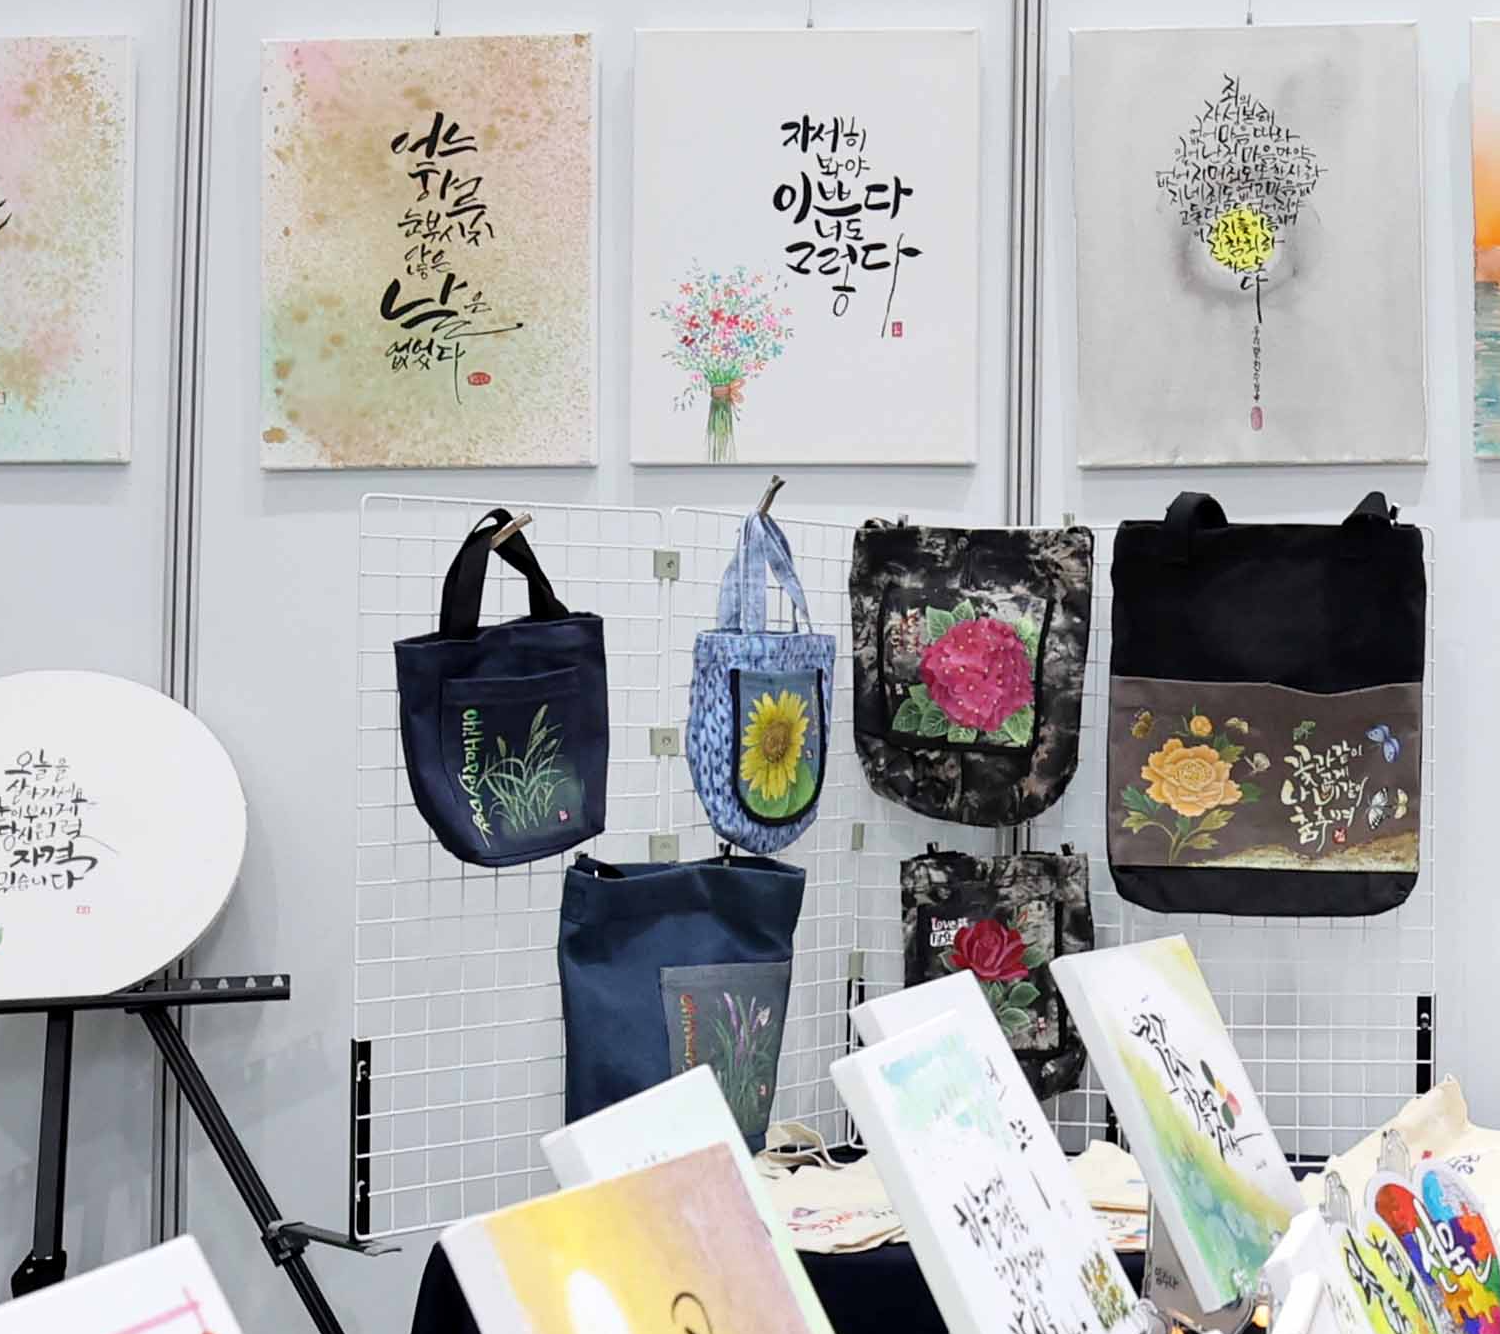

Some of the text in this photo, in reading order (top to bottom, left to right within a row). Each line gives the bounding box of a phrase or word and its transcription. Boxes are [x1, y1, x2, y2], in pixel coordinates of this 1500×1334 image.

[390, 111, 478, 159] 어느
[780, 114, 867, 154] 자세히
[815, 152, 871, 179] 봐야
[408, 161, 488, 218] 하루
[772, 170, 914, 225] 이쁘다
[397, 209, 496, 247] 눈부시지
[814, 218, 865, 243] 너도
[404, 243, 452, 280] 않은
[380, 272, 524, 340] 날은
[785, 232, 924, 339] 그렇다
[385, 338, 467, 406] 없었다
[4, 748, 71, 783] 오늘을
